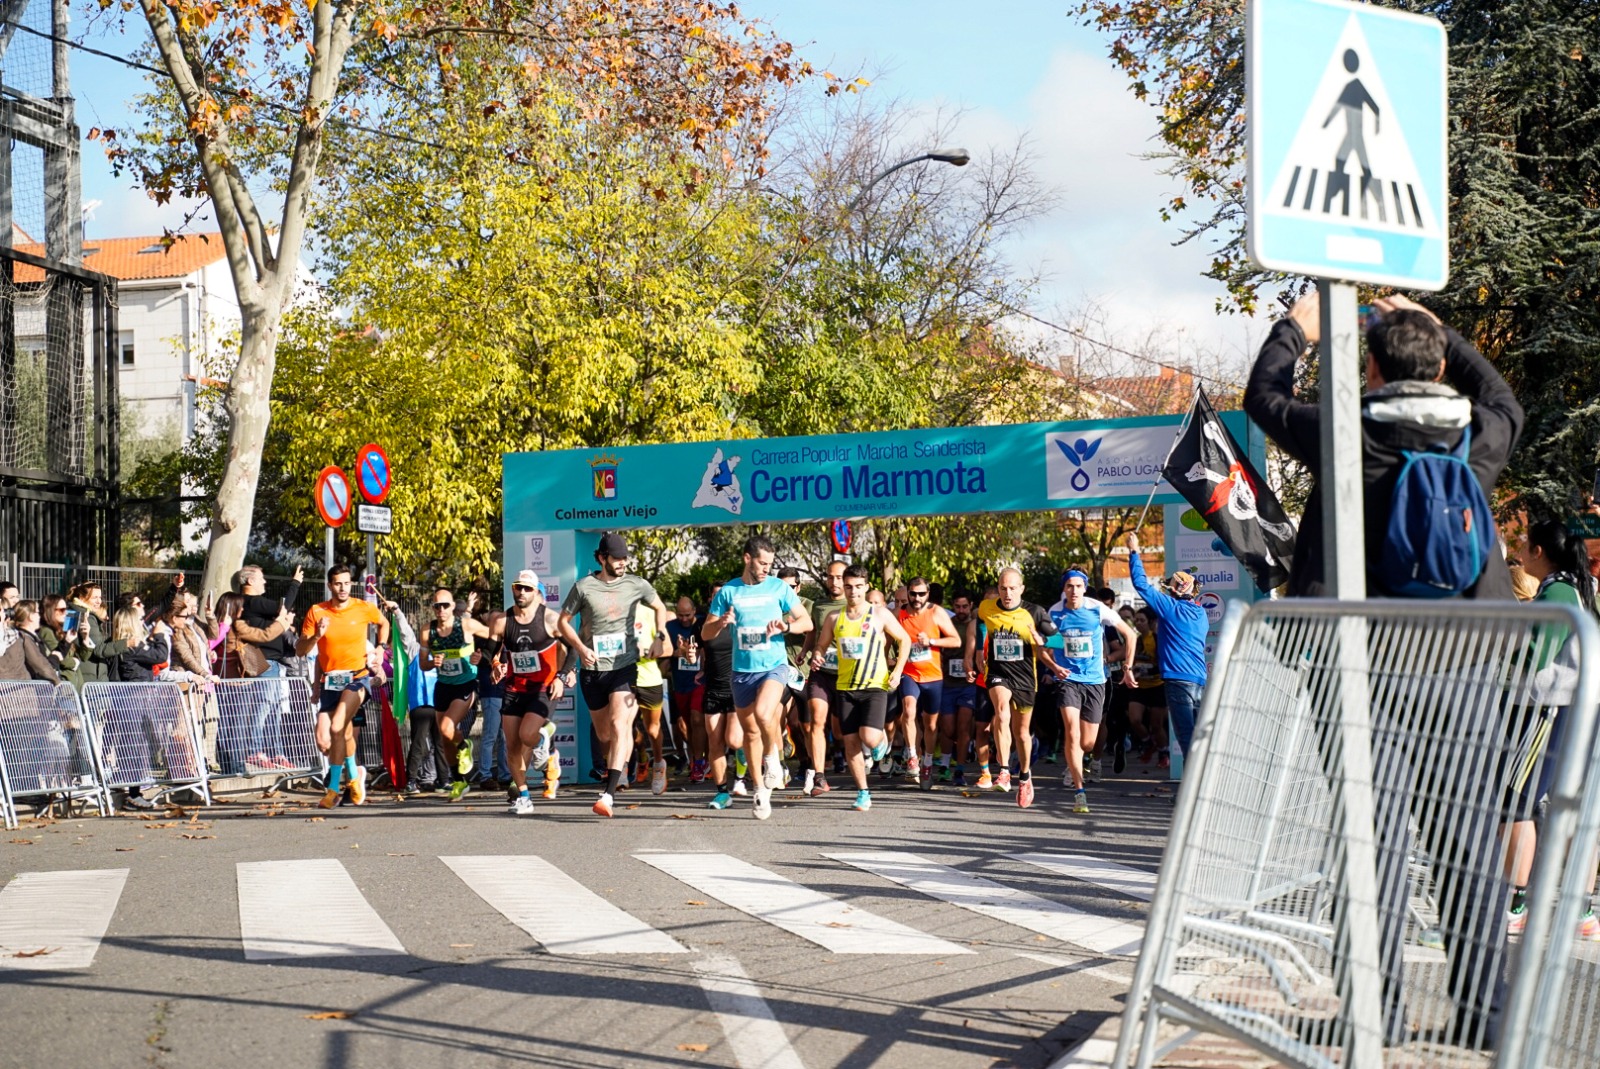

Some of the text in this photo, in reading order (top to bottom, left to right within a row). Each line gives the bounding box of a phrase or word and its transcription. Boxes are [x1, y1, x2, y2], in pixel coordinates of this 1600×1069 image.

[752, 439, 986, 467] Carrera Popular Marcha Senderista
[1097, 465, 1132, 478] PABLO
[750, 461, 987, 504] Cerro Marmota
[555, 504, 658, 521] Colmenar Viejo
[834, 502, 898, 513] COLMENAR VIEJO
[1001, 645, 1015, 654] 323
[517, 657, 532, 666] 215
